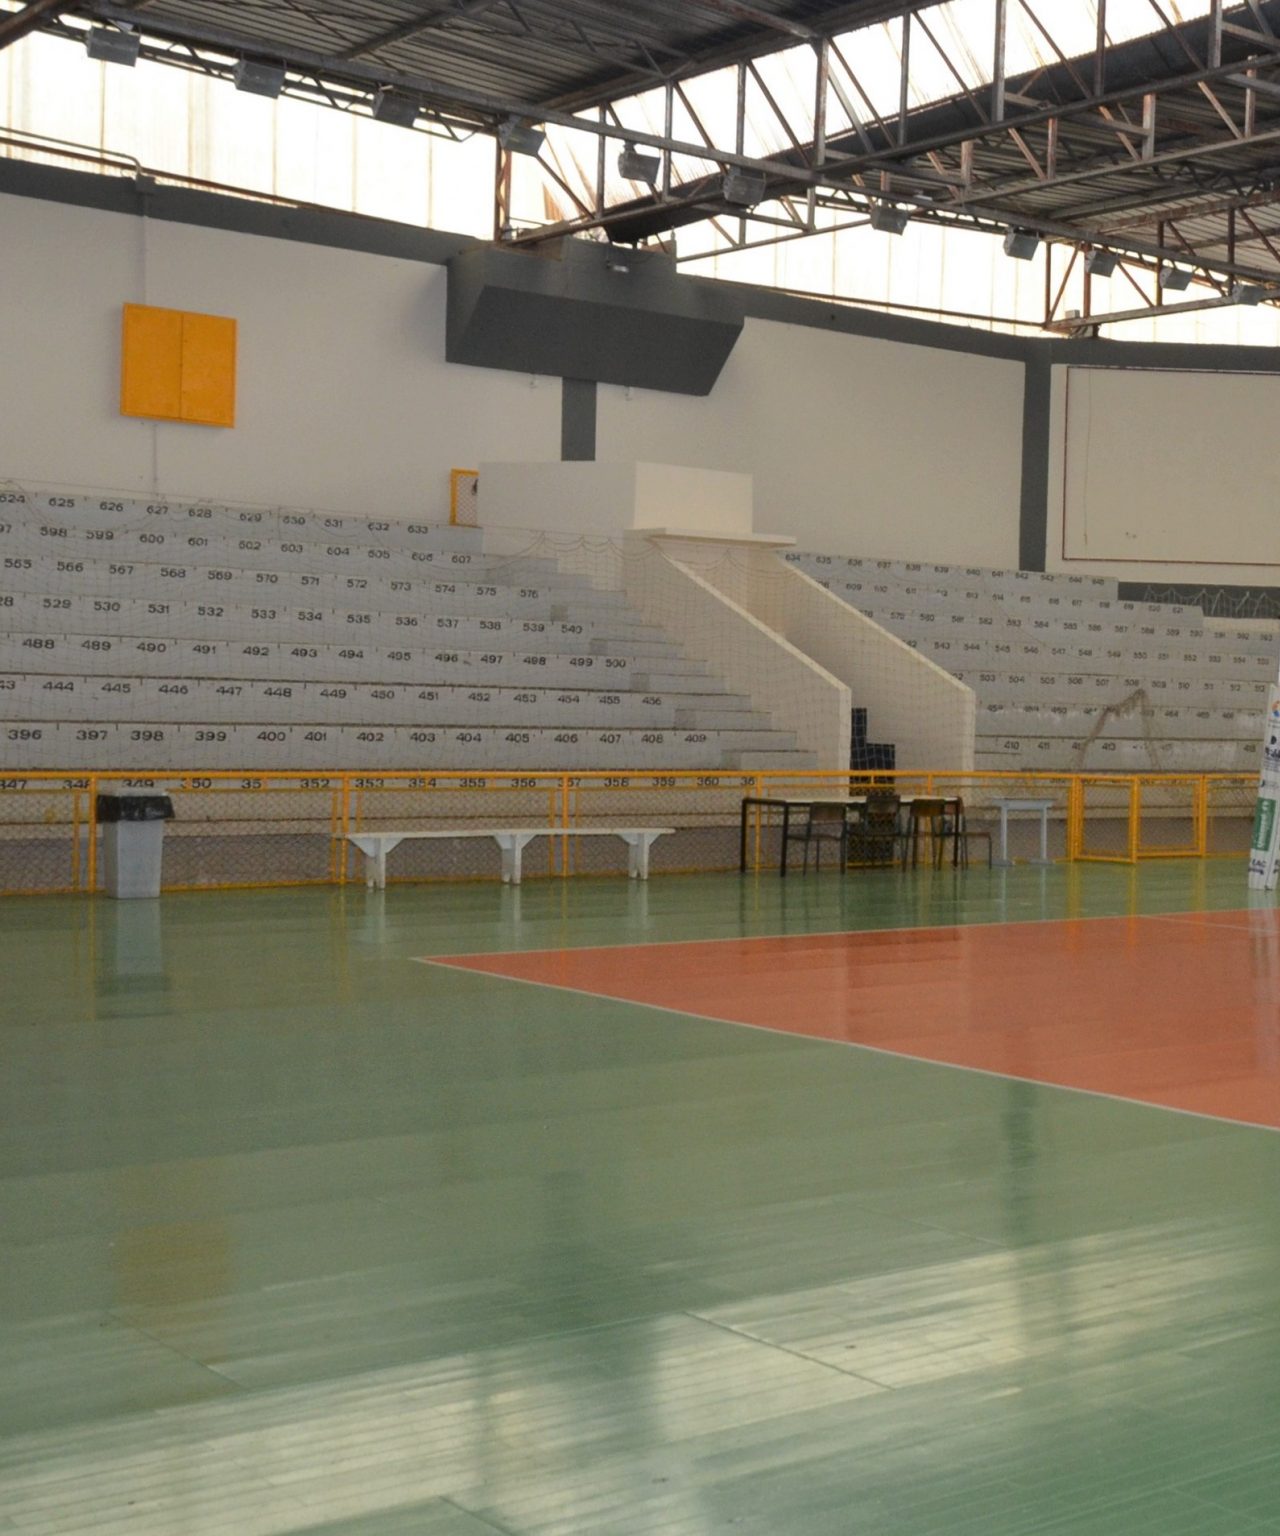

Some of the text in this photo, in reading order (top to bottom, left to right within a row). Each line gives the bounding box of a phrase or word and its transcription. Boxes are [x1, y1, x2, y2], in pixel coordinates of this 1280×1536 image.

[49, 498, 75, 508] 625
[100, 501, 124, 512] 626
[146, 505, 168, 516] 627
[188, 508, 212, 519] 628
[407, 525, 428, 534] 633
[0, 524, 12, 534] 97
[40, 526, 67, 537] 598
[139, 533, 164, 544] 600
[188, 537, 208, 547] 601
[280, 543, 303, 554] 603
[452, 555, 471, 564] 607
[4, 558, 539, 599] 565 566 567 568 569 570 571 572 573 574 575 576
[0, 596, 583, 634] 28 529 530 531 532 533 534 535 536 537 538 539 540
[22, 638, 626, 668] 488 489 490 491 492 493 494 495 496 497 498 499 500
[0, 680, 16, 690] 43
[42, 681, 74, 692] 444
[101, 683, 131, 694] 445
[158, 685, 189, 695] 446
[216, 686, 243, 696] 447
[263, 687, 292, 698] 448
[320, 689, 347, 699] 449
[370, 690, 395, 700] 450
[418, 691, 439, 701] 451
[467, 692, 491, 702] 452
[513, 694, 537, 704] 453
[557, 695, 580, 704] 454
[7, 729, 707, 744] 396 397 398 399 400 401 402 403 404 405 406 407 408 409
[241, 779, 262, 789] 35
[300, 779, 330, 789] 352
[355, 779, 384, 788] 353
[459, 779, 486, 788] 355
[511, 778, 536, 787] 356
[604, 778, 629, 787] 358
[652, 778, 675, 787] 359
[697, 778, 719, 787] 360
[741, 778, 755, 787] 36
